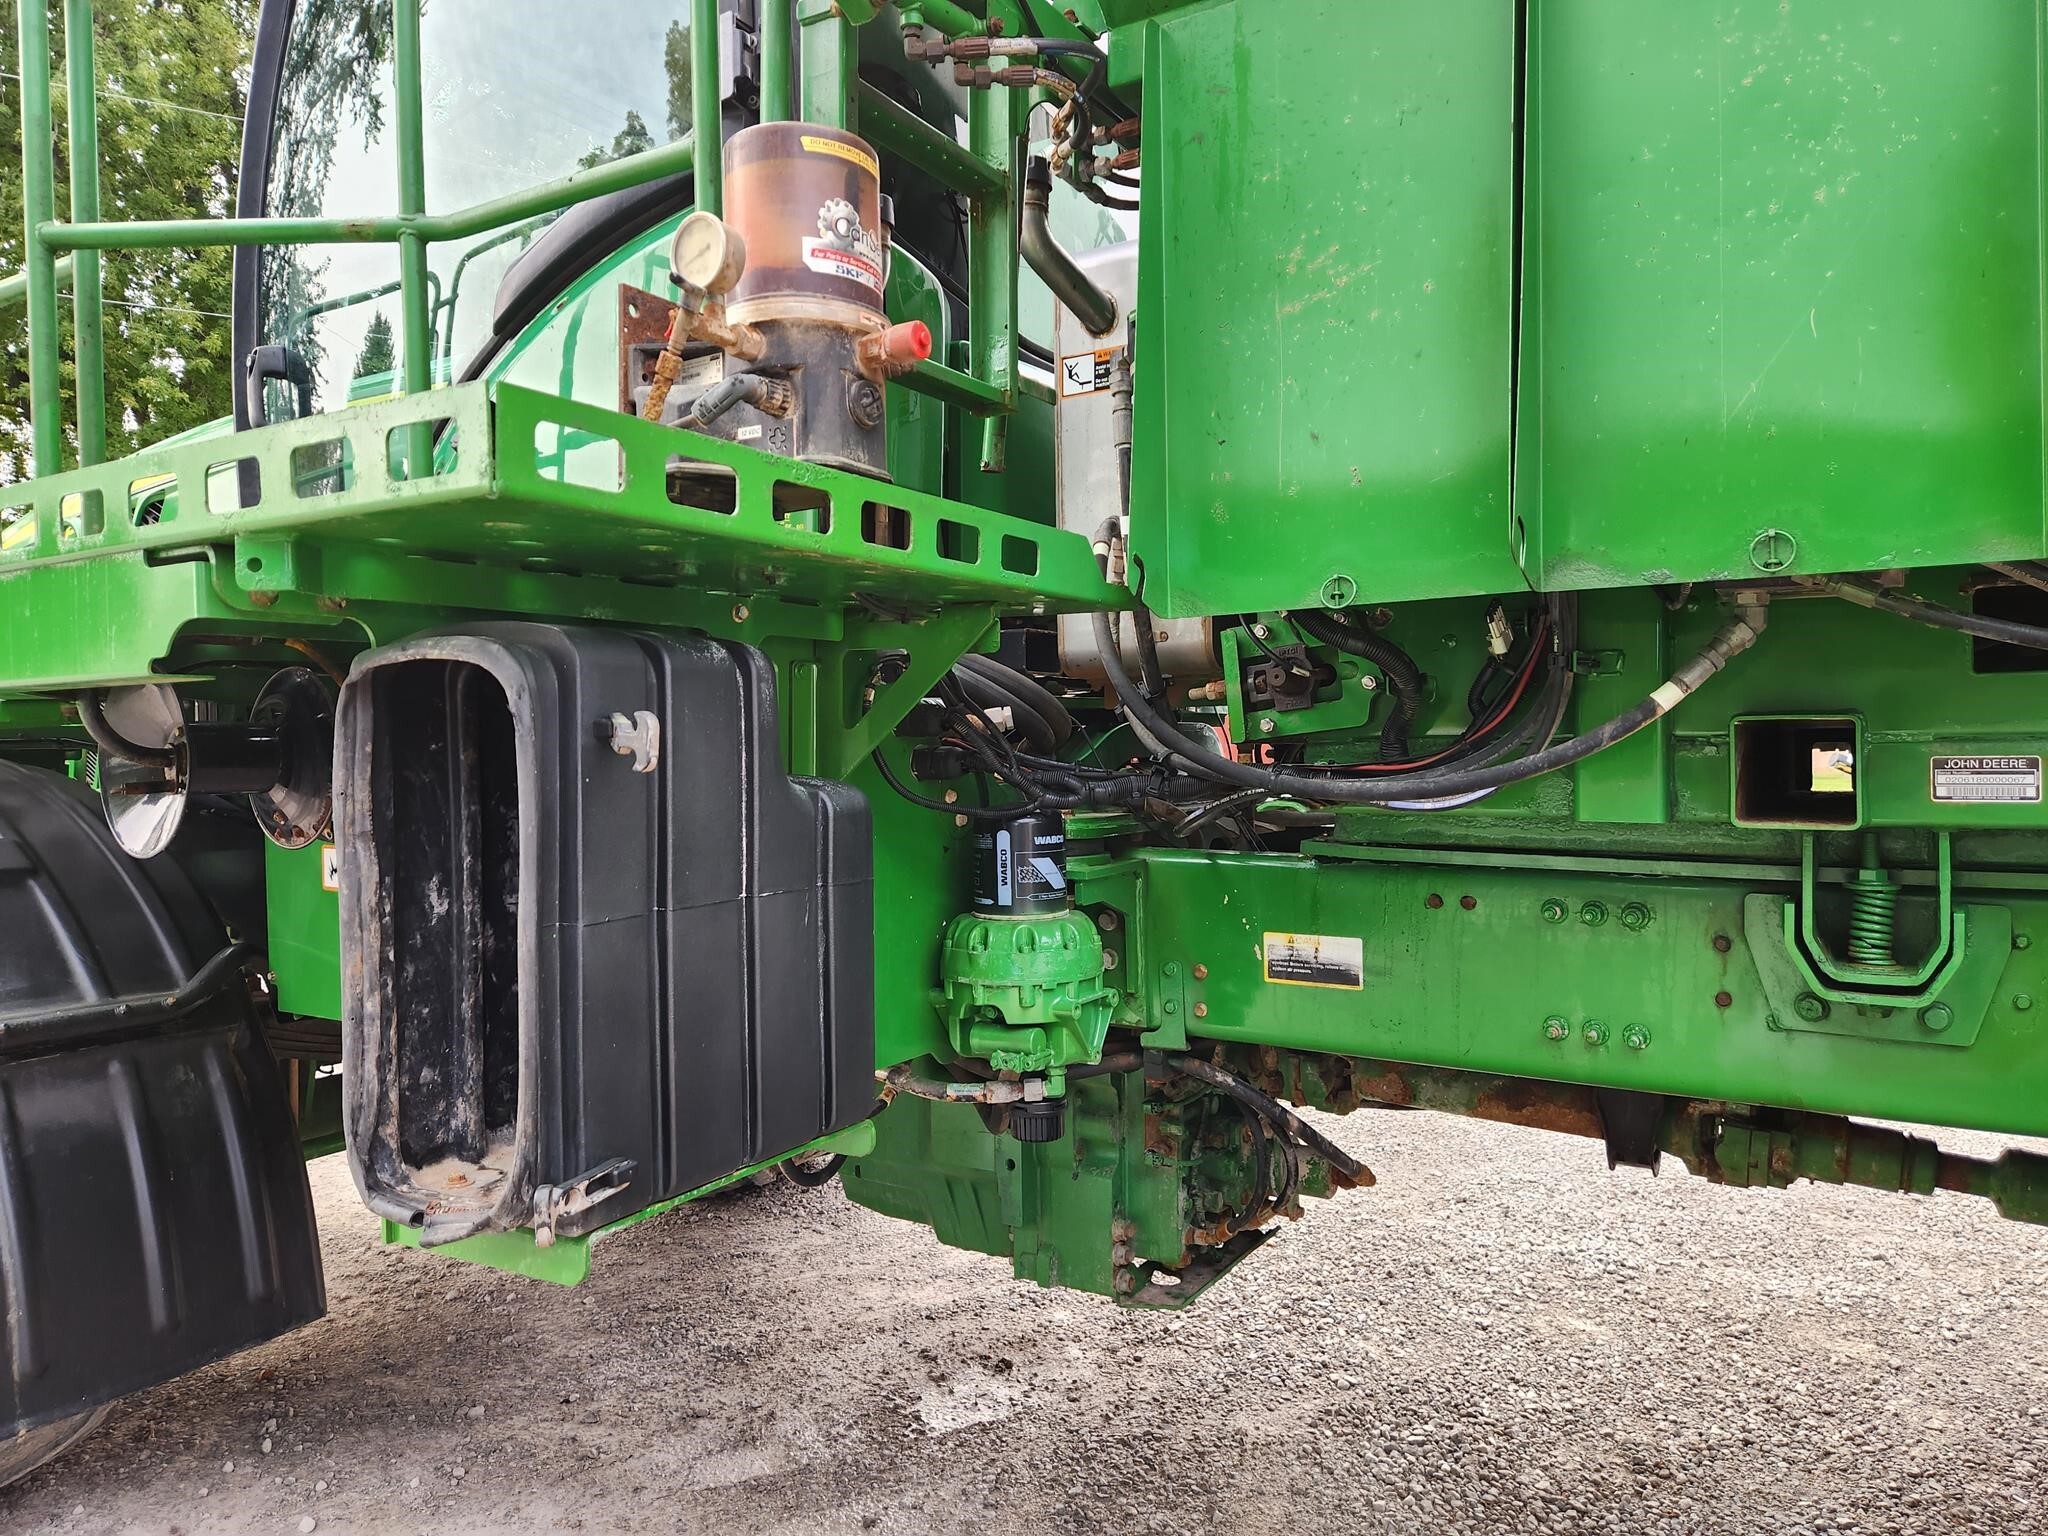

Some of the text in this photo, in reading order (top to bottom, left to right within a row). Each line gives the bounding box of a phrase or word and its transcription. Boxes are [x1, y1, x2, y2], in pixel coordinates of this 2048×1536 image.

[836, 265, 863, 279] SKF
[1944, 759, 2027, 769] JOHN DEERE
[1944, 776, 2027, 784] 0206180000067
[1000, 849, 1008, 886] WABCO
